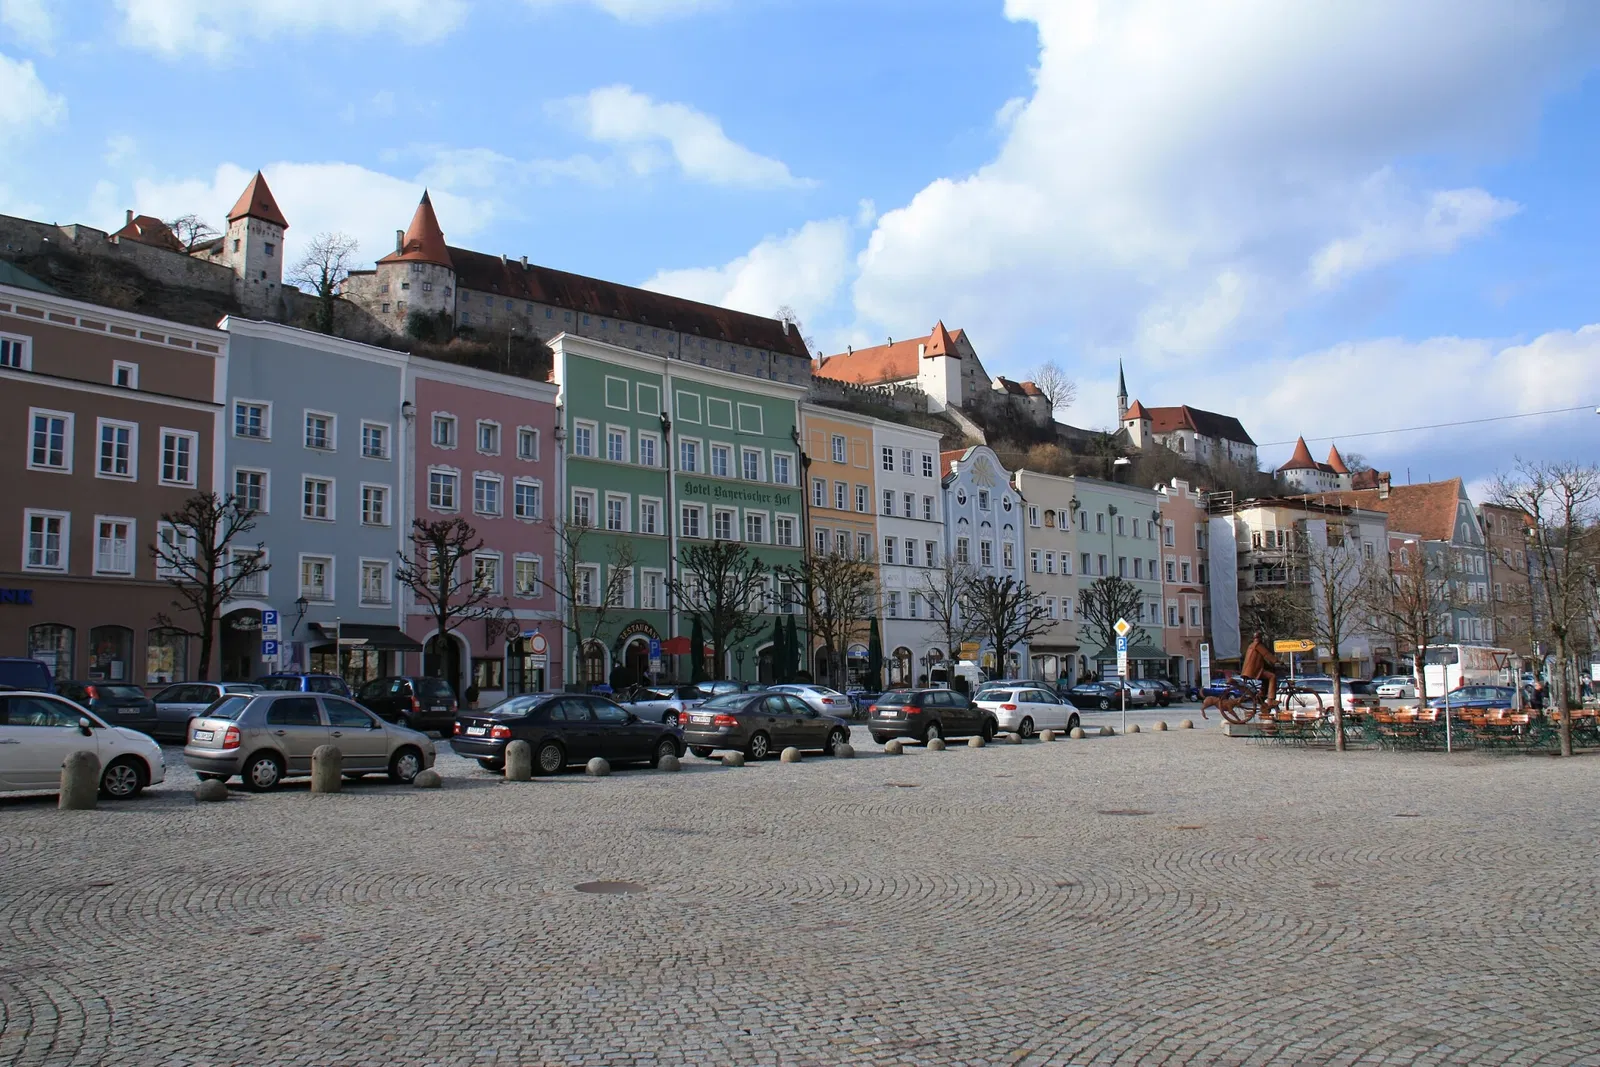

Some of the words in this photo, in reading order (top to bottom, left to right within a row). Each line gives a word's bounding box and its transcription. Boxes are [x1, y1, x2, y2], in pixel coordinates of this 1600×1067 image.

[684, 481, 710, 496] Hotel
[714, 485, 771, 504] Bayerischer
[774, 493, 791, 507] Hof
[265, 612, 274, 624] P
[265, 641, 274, 654] P
[651, 641, 658, 654] P
[1118, 638, 1125, 650] P
